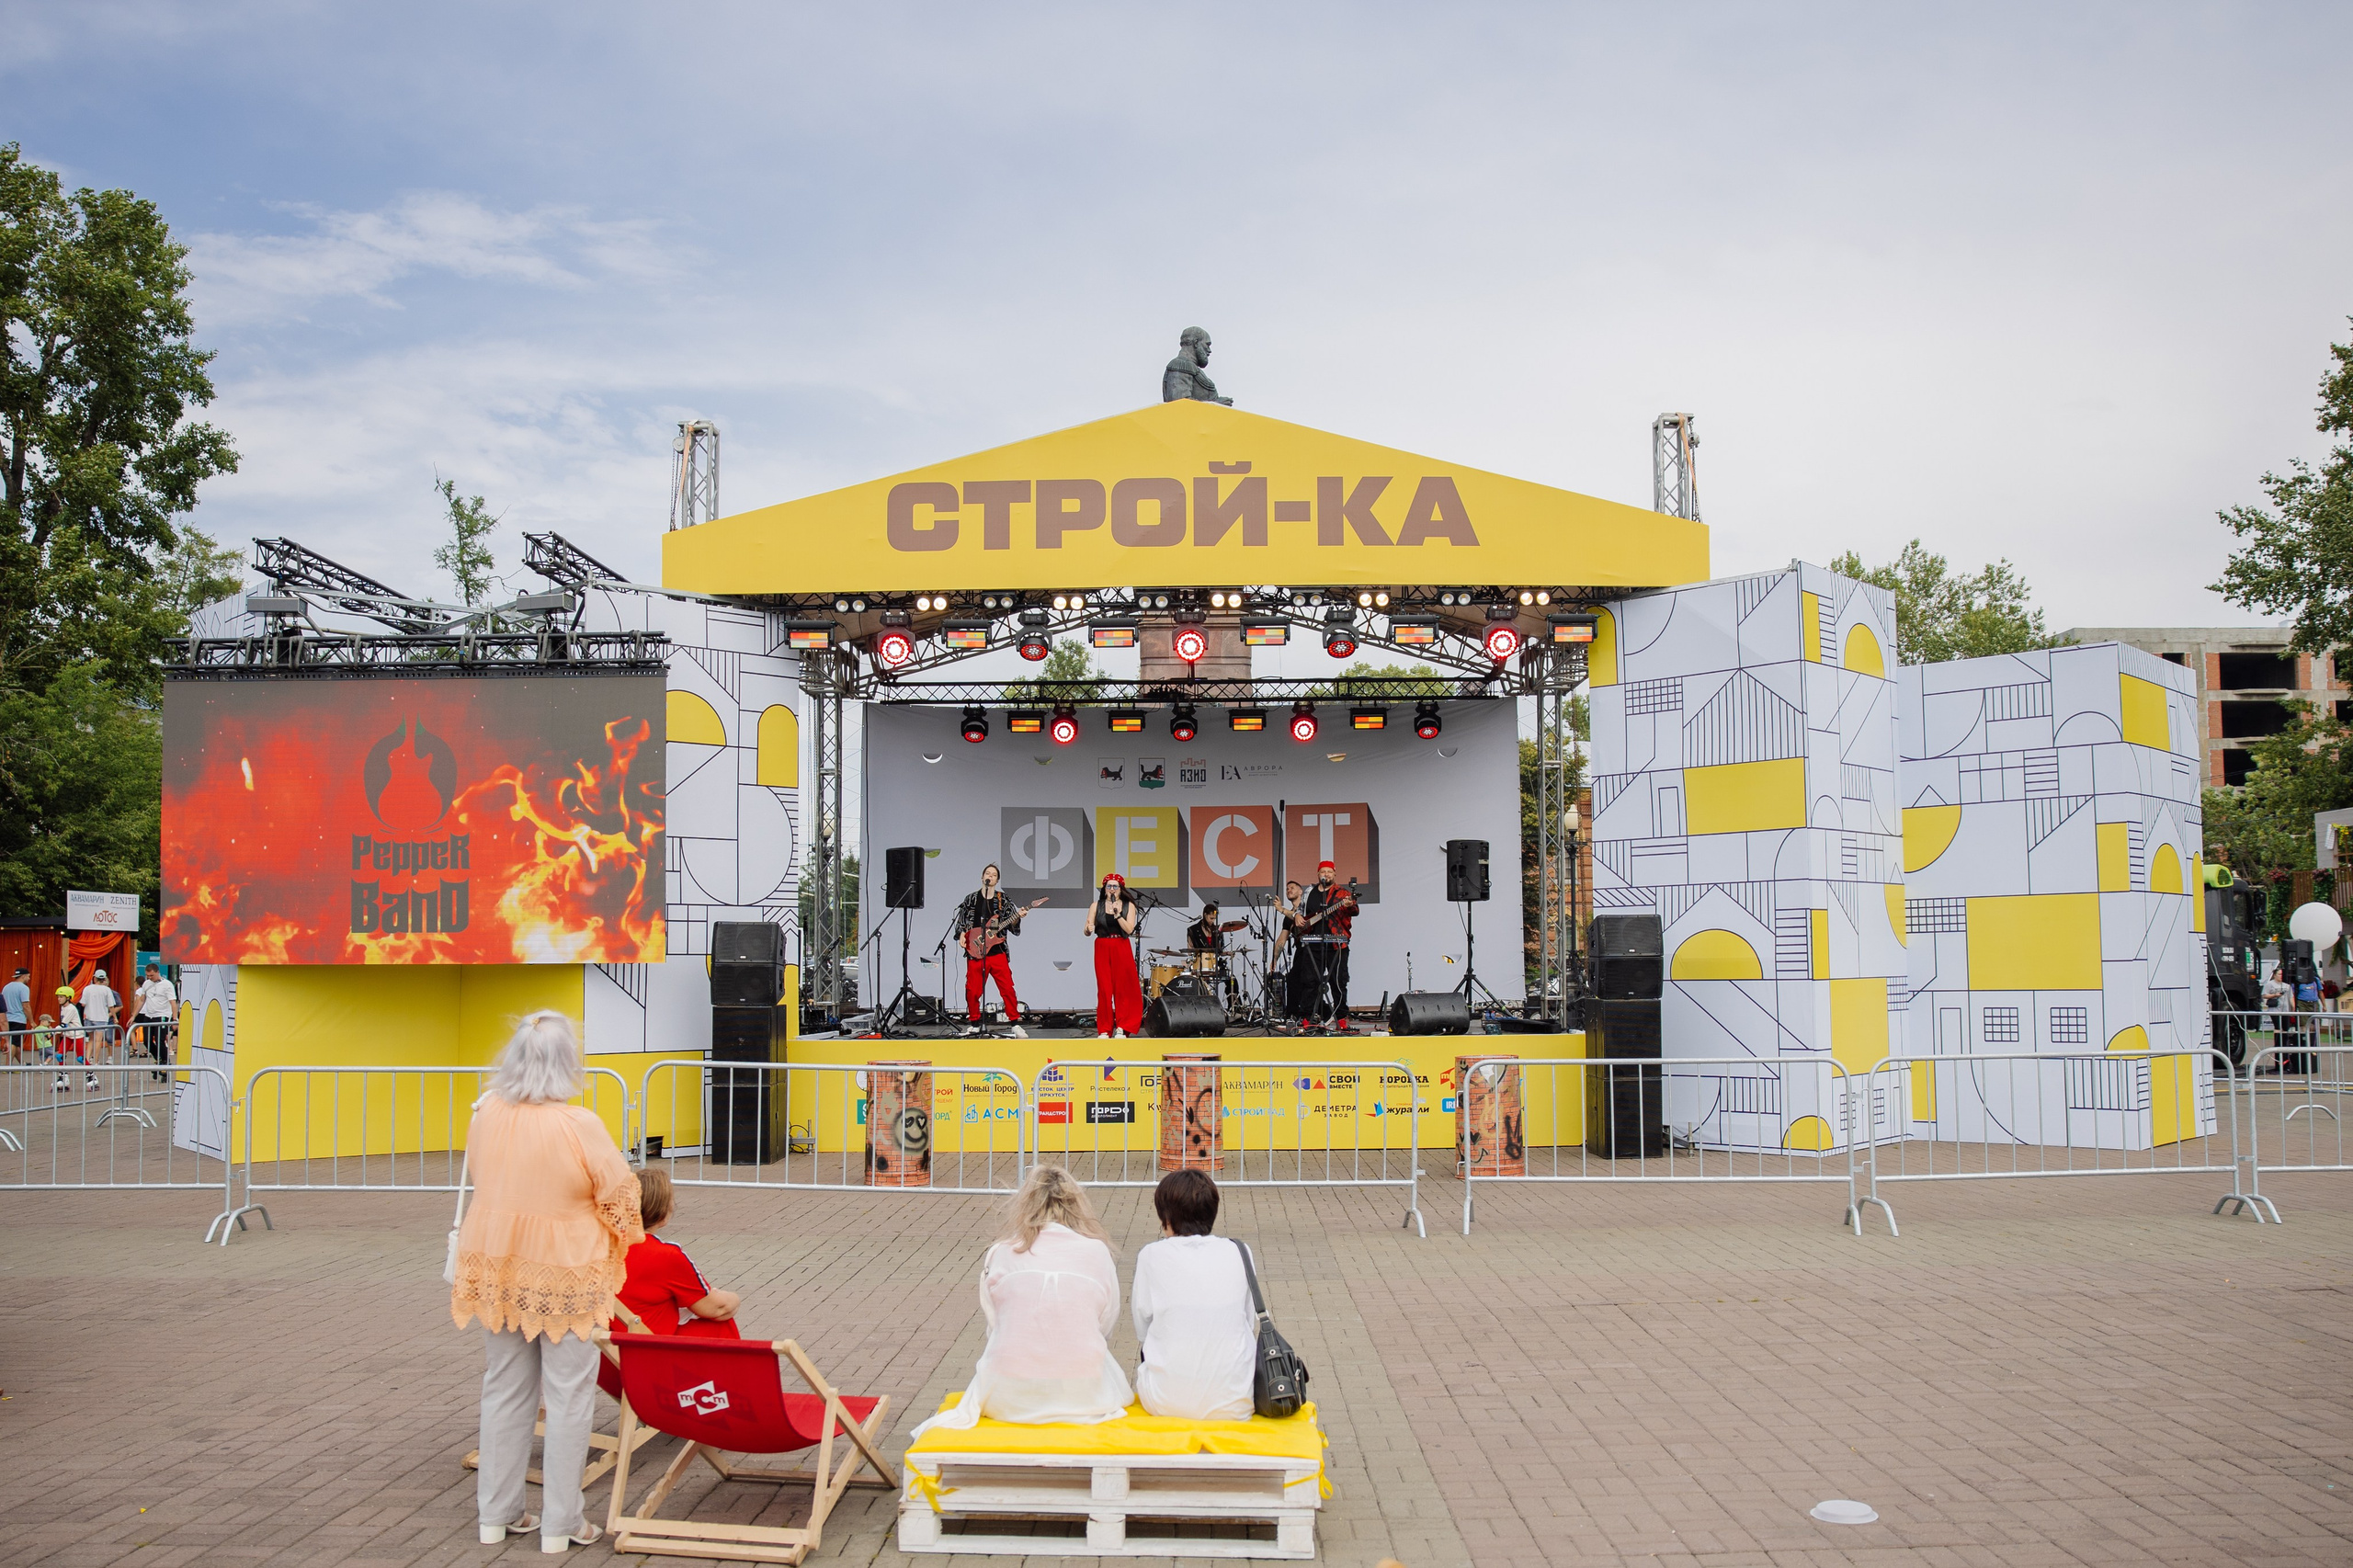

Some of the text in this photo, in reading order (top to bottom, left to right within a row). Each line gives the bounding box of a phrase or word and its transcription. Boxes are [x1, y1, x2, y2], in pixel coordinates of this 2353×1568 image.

[887, 460, 1481, 551] СТРОЙ-КА
[1009, 812, 1351, 881] ФЕСТ
[71, 894, 105, 903] АКВАМАРИН
[110, 896, 137, 905] ZENITH
[93, 910, 118, 923] ЛОТОС
[963, 1084, 1017, 1094] Новый Город
[983, 1108, 1019, 1119] АСМ
